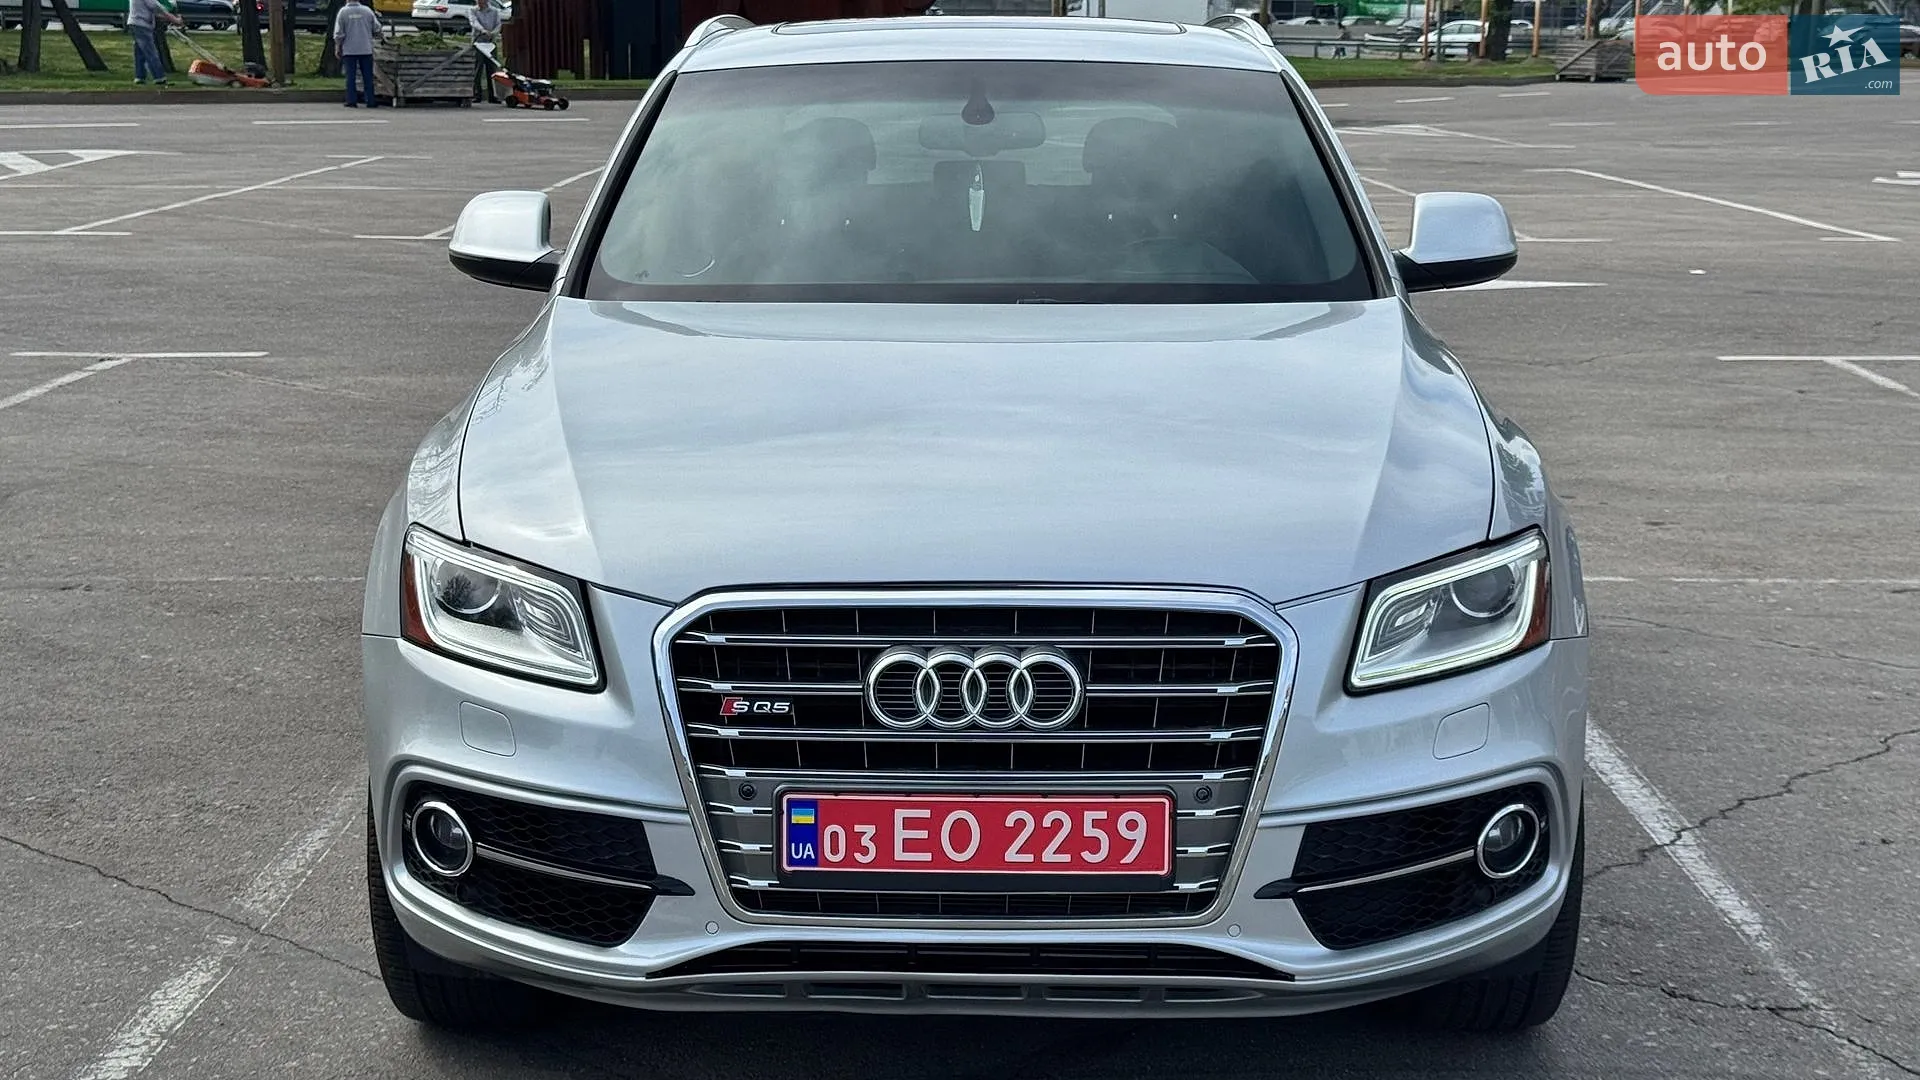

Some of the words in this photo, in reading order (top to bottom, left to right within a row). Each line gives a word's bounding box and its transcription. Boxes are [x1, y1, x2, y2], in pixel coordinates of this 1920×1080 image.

[791, 843, 815, 859] UA
[823, 824, 876, 864] 03
[894, 808, 981, 862] EO
[1004, 810, 1147, 864] 2259
